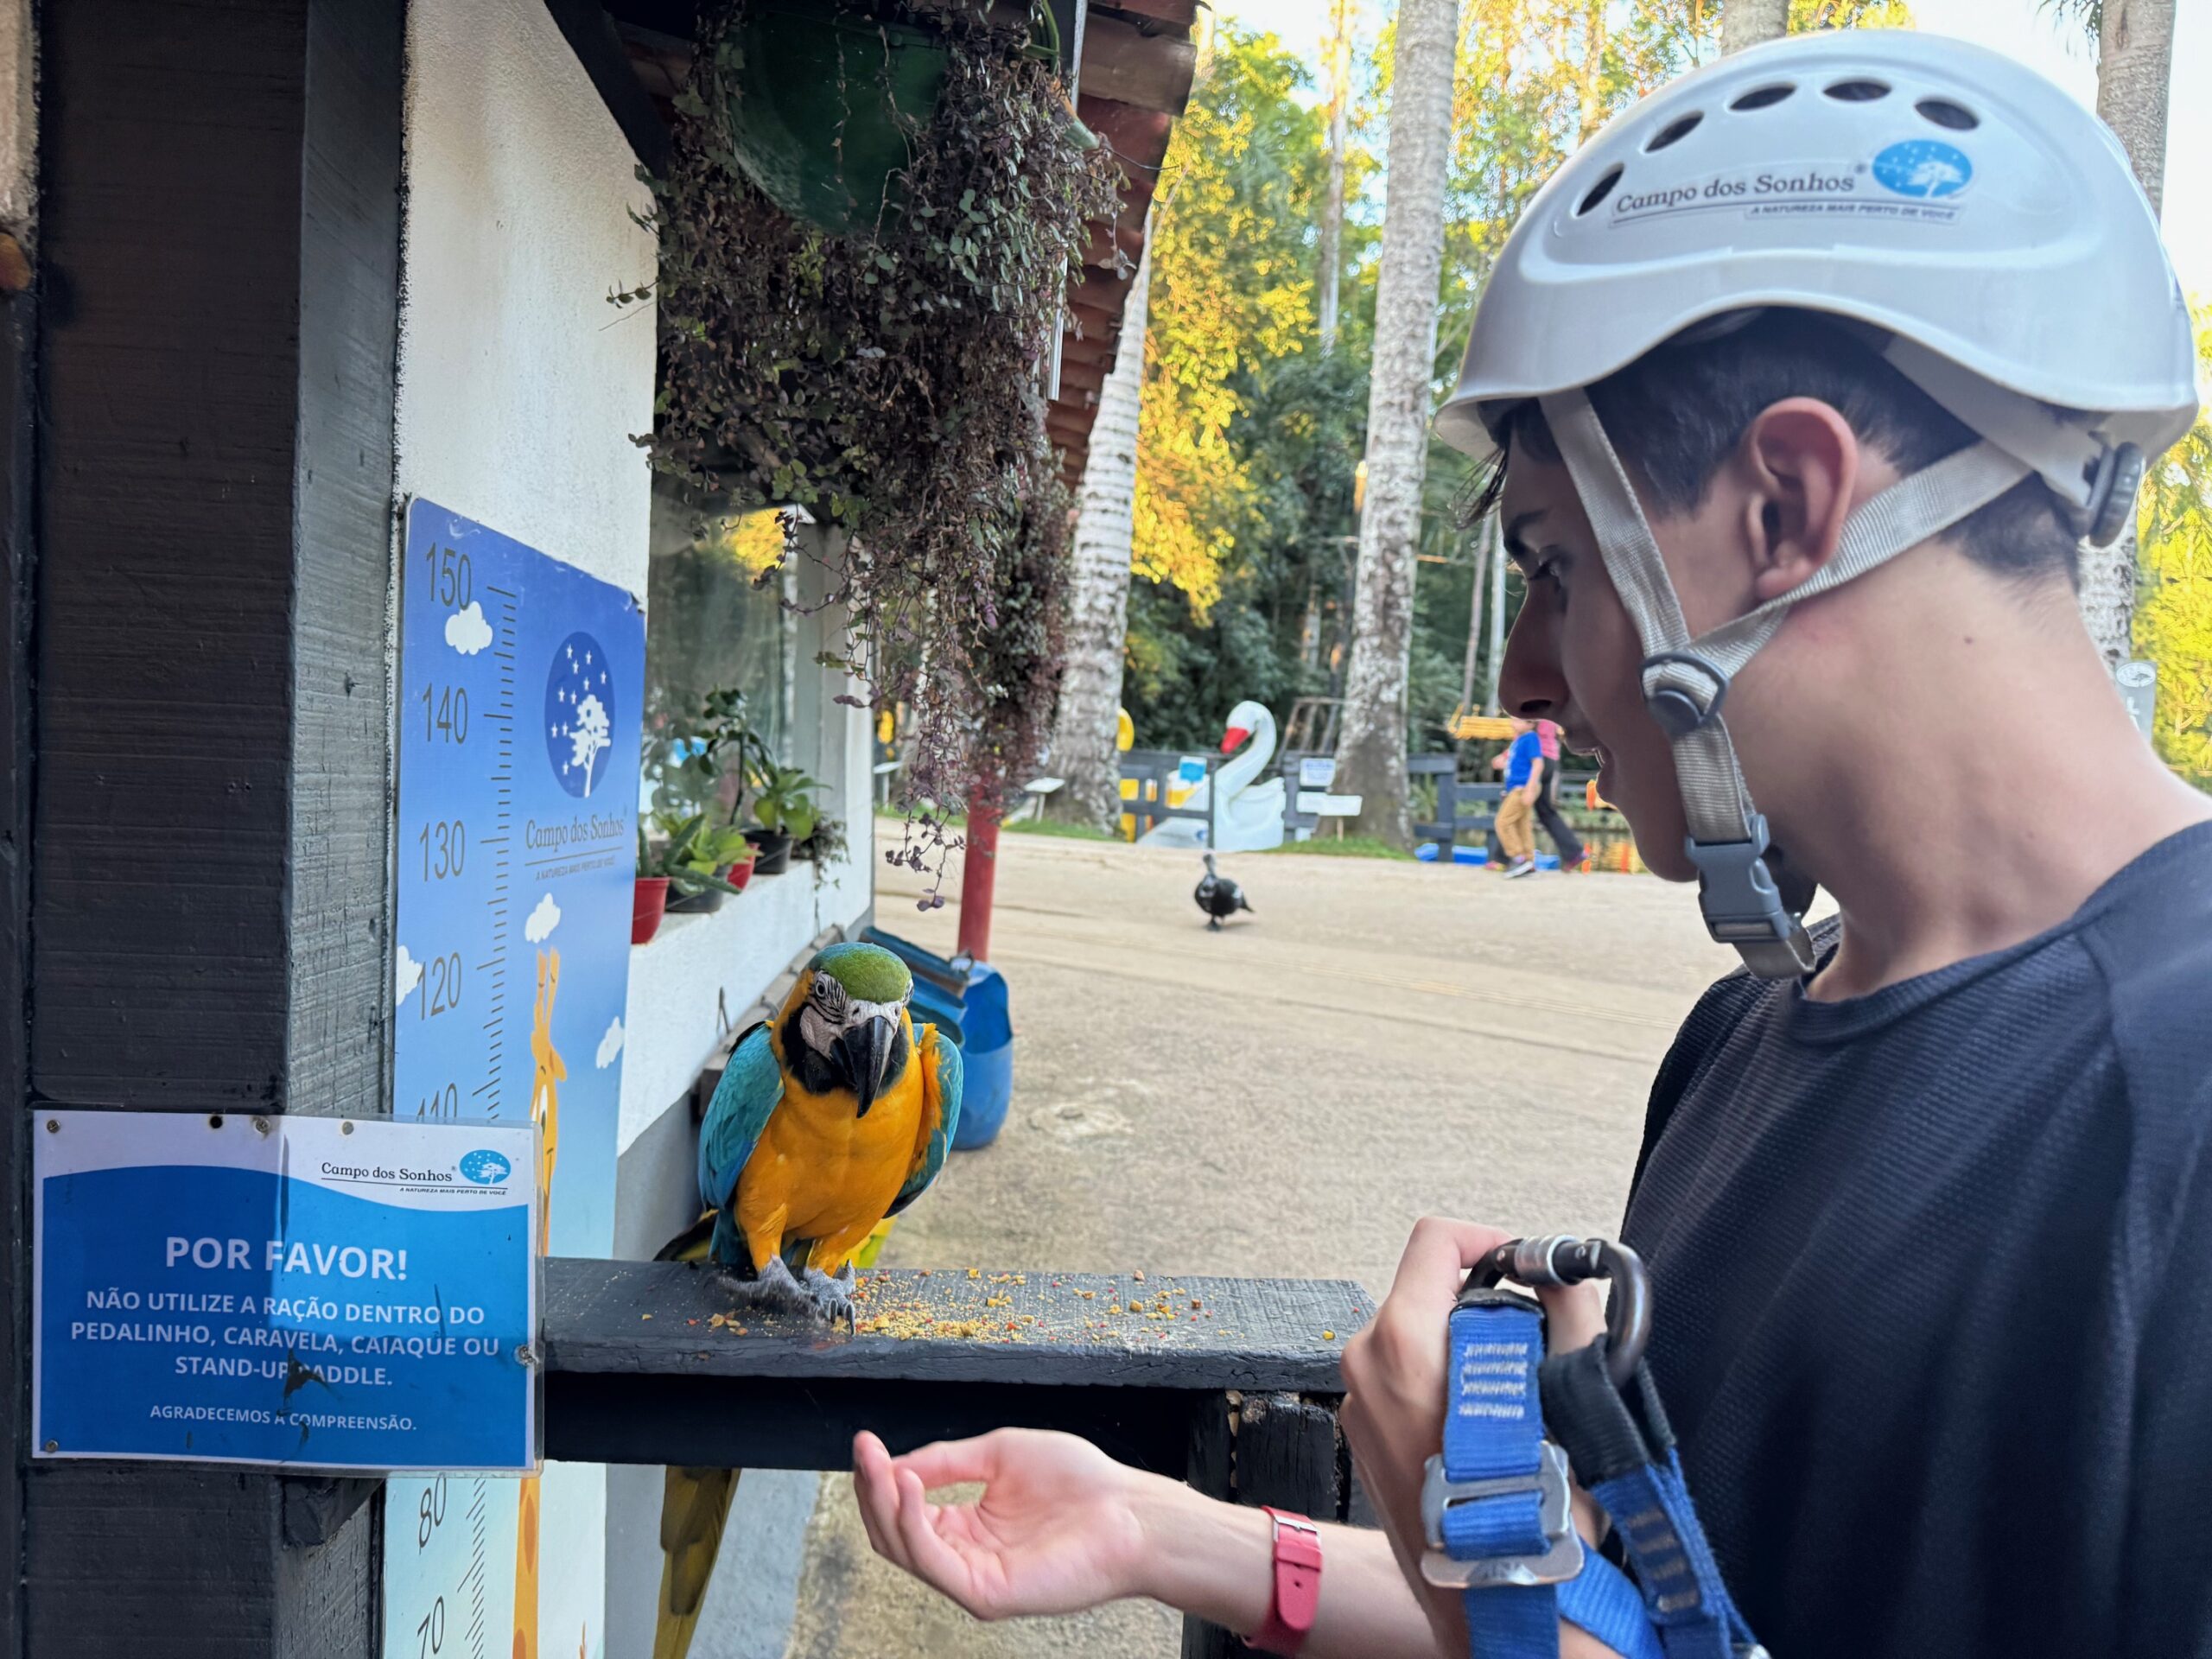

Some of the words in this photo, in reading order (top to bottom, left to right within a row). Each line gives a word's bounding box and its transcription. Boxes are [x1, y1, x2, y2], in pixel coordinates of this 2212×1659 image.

[1617, 187, 1697, 213] Campo
[1703, 178, 1746, 199] dos
[1753, 172, 1855, 194] Sonhos
[425, 542, 472, 611] 150
[423, 683, 468, 745] 140
[420, 820, 465, 882] 130
[525, 819, 569, 853] Campo
[570, 814, 588, 843] dos
[590, 812, 624, 840] Sonhos
[417, 952, 461, 1020] 120
[321, 1161, 369, 1179] Campo
[372, 1166, 396, 1179] dos
[399, 1168, 453, 1182] Sonhos
[166, 1236, 252, 1270] POR
[265, 1240, 407, 1281] FAVOR!
[87, 1287, 141, 1310] NÃO
[148, 1293, 234, 1313] UTILIZE
[239, 1296, 256, 1314] A
[264, 1296, 338, 1323] RAÇÃO
[346, 1304, 442, 1324] DENTRO
[449, 1306, 485, 1325] DO
[71, 1322, 216, 1347] PEDALINHO,
[224, 1327, 344, 1355] CARAVELA,
[351, 1336, 456, 1359] CAIAQUE
[463, 1338, 499, 1356] OU
[175, 1356, 289, 1380] STAND-UP
[149, 1405, 270, 1424] AGRADECEMOS
[289, 1413, 417, 1431] COMPREENSÃO.
[419, 1473, 447, 1548] 80
[417, 1595, 445, 1659] 70
